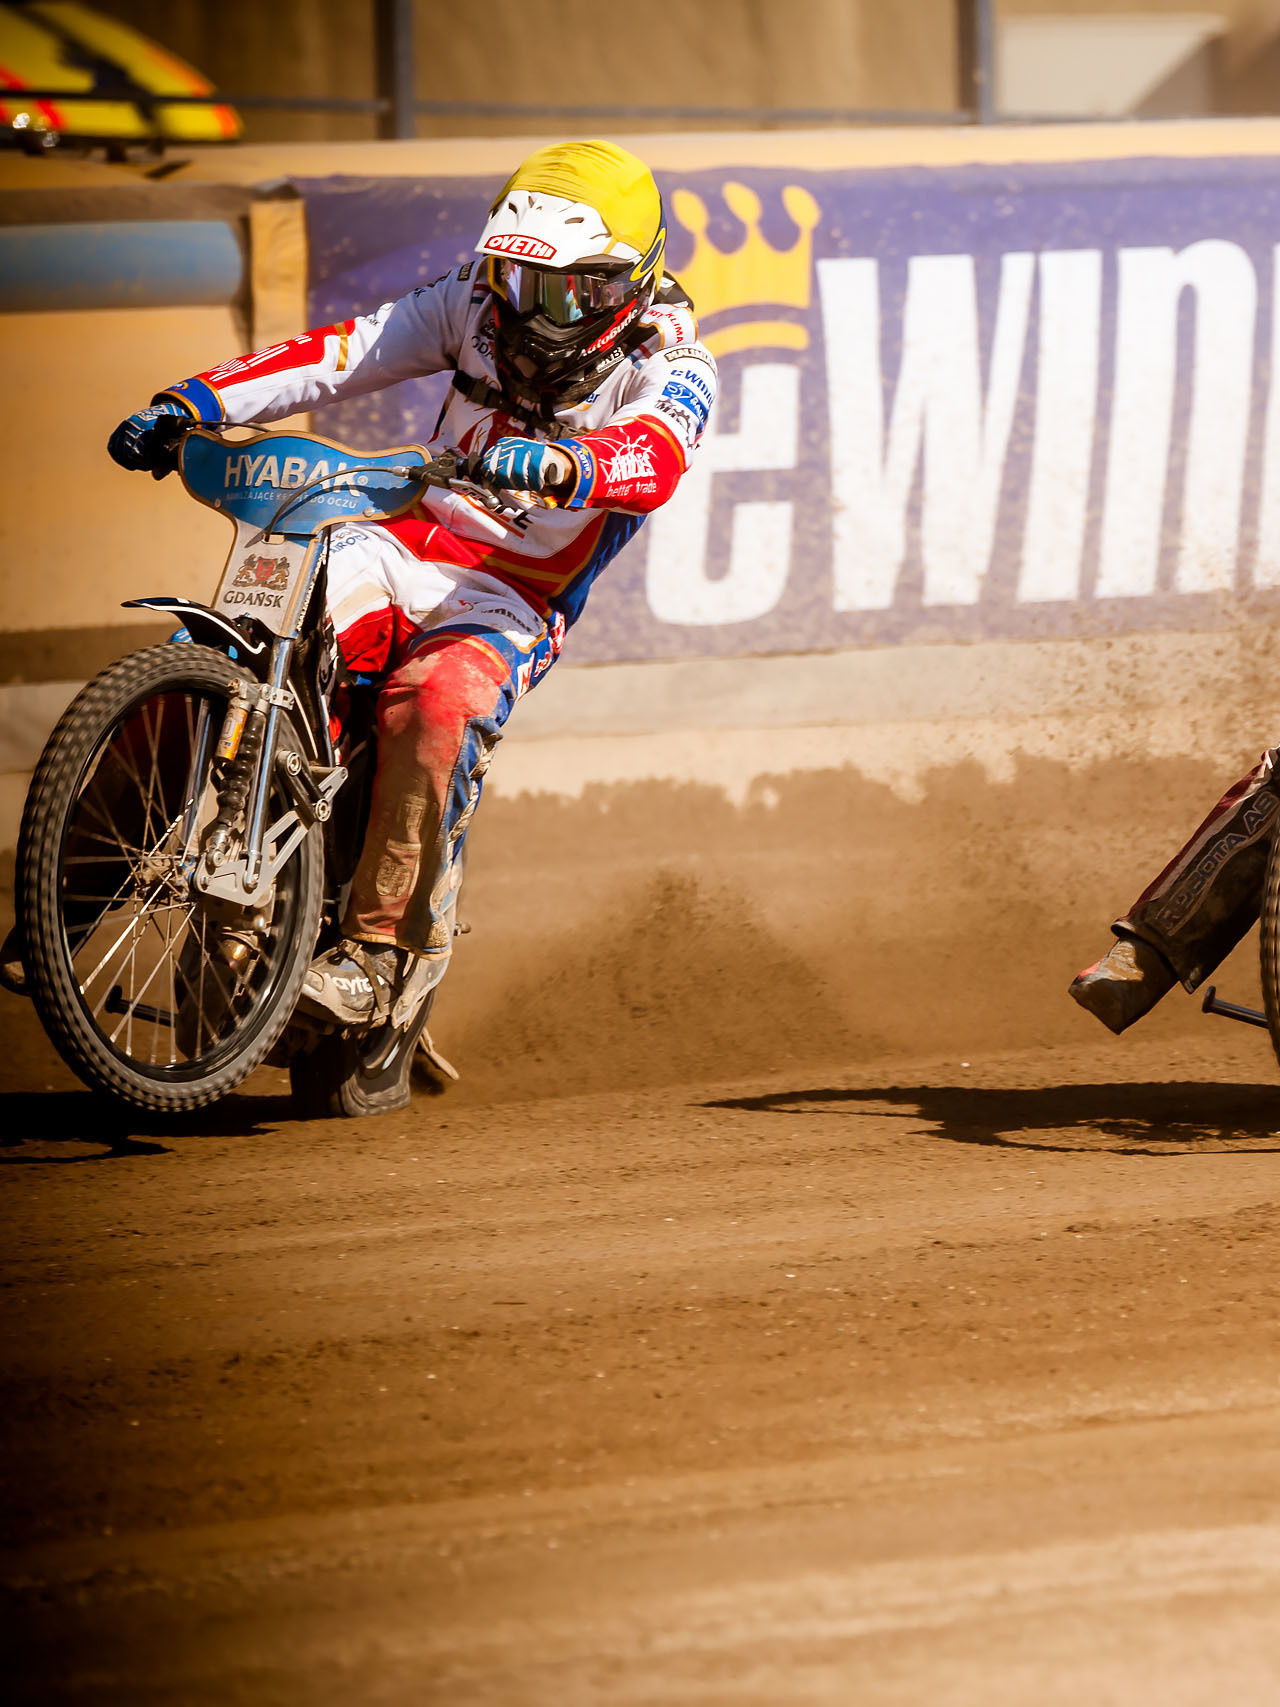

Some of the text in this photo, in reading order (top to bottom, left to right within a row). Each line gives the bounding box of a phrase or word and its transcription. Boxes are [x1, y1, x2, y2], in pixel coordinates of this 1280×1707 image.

[224, 455, 366, 497] HYABAK
[636, 480, 657, 494] trade
[326, 497, 357, 510] OCZU
[222, 590, 285, 609] GDAŃSK
